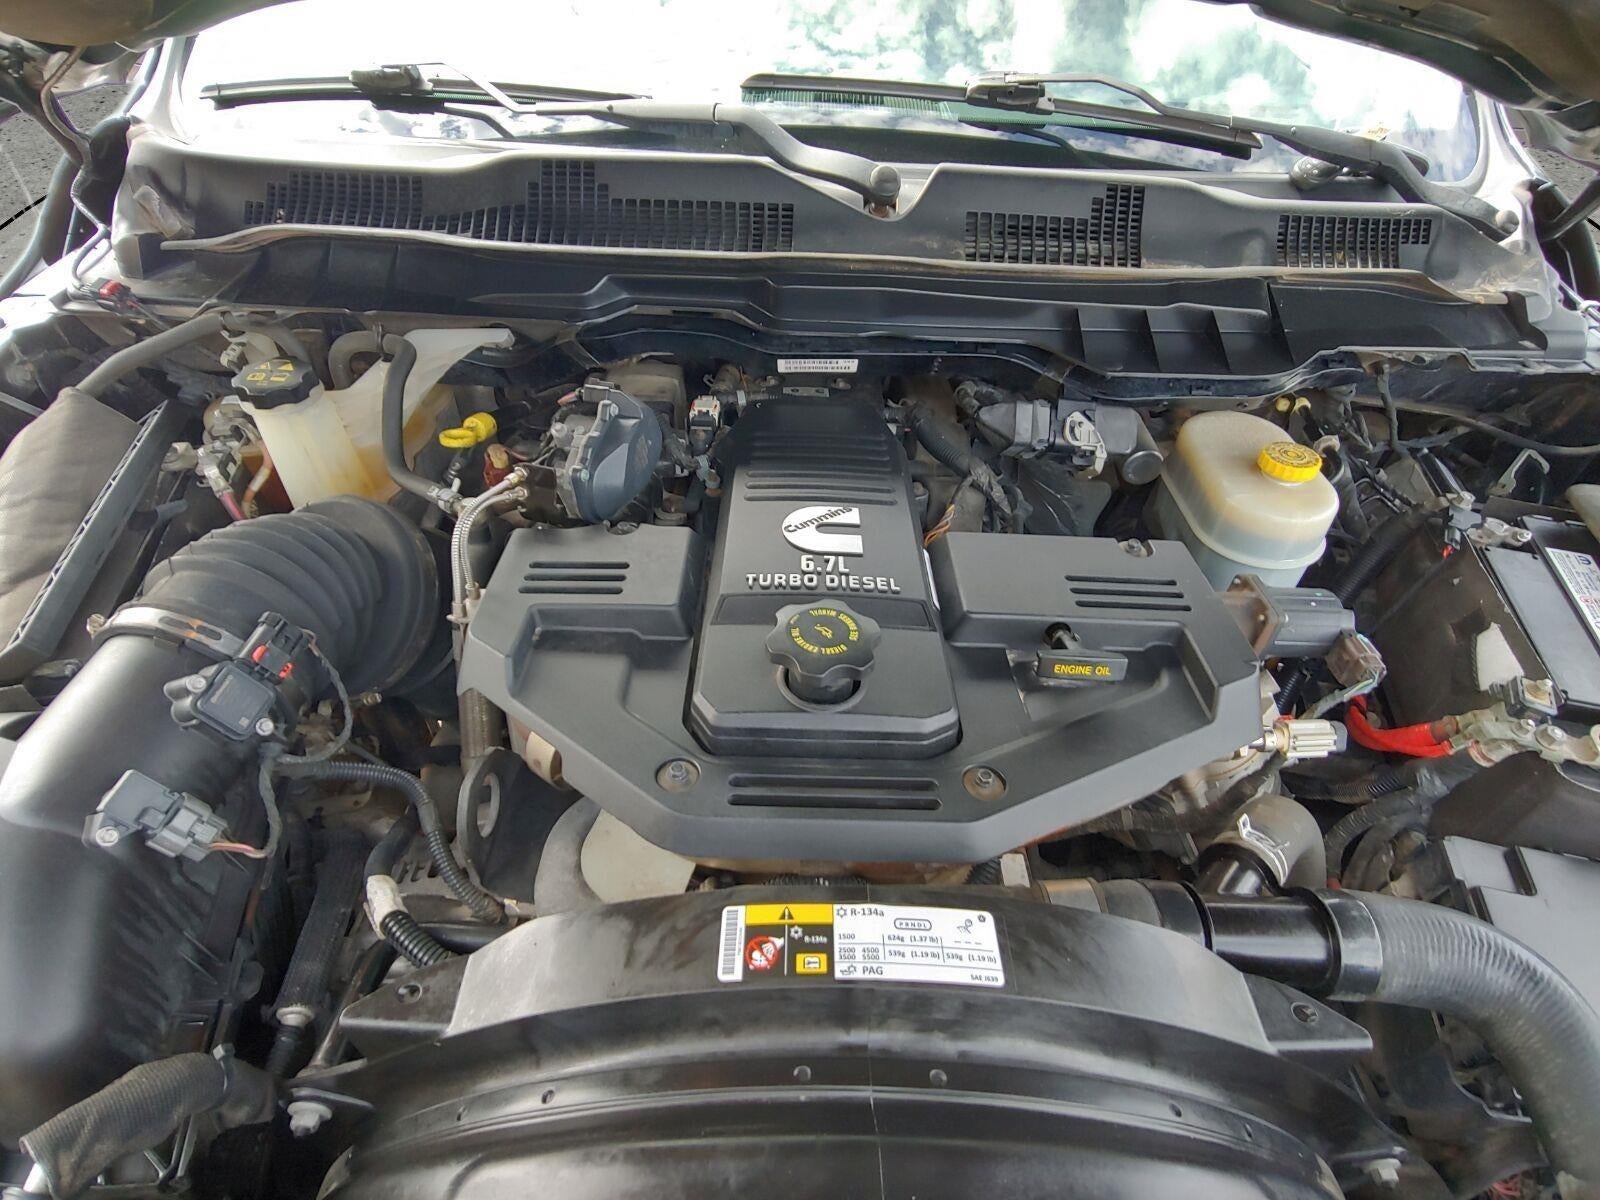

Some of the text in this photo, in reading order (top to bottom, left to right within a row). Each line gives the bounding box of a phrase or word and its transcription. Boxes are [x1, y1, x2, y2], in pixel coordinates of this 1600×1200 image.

[783, 506, 853, 533] Cummins
[800, 554, 850, 574] 6.7L
[746, 573, 901, 594] TURBO DIESEL
[1053, 664, 1112, 676] ENGINE OIL
[850, 907, 885, 917] R-134a
[887, 934, 905, 943] 624g
[838, 946, 880, 954] 2500 4500
[888, 949, 906, 958] 539g
[861, 953, 880, 961] 5500
[862, 965, 884, 976] PAG
